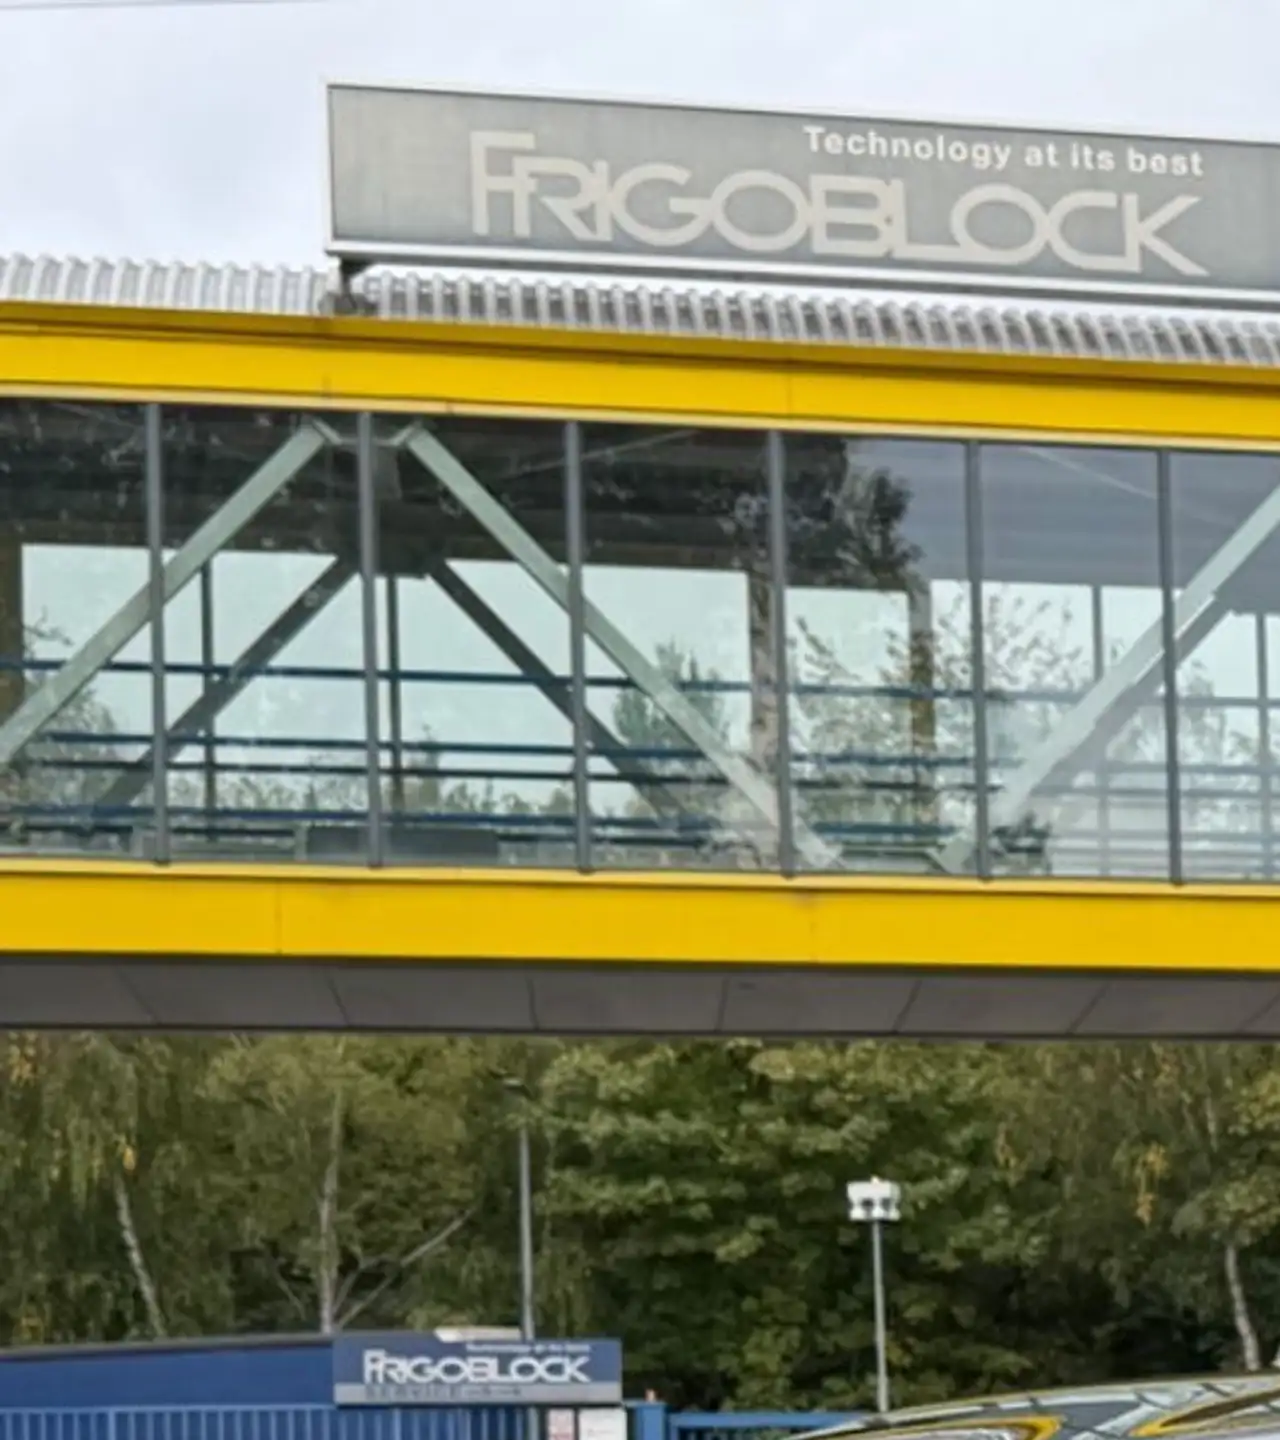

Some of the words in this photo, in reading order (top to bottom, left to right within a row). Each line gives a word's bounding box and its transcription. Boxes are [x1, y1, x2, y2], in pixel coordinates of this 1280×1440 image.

[803, 125, 1011, 171] Technology
[1024, 141, 1059, 168] at
[1070, 142, 1115, 172] its
[1127, 147, 1205, 177] best
[469, 130, 1210, 276] FRIGOBLOCK
[363, 1349, 592, 1383] FRIGOBLOCK
